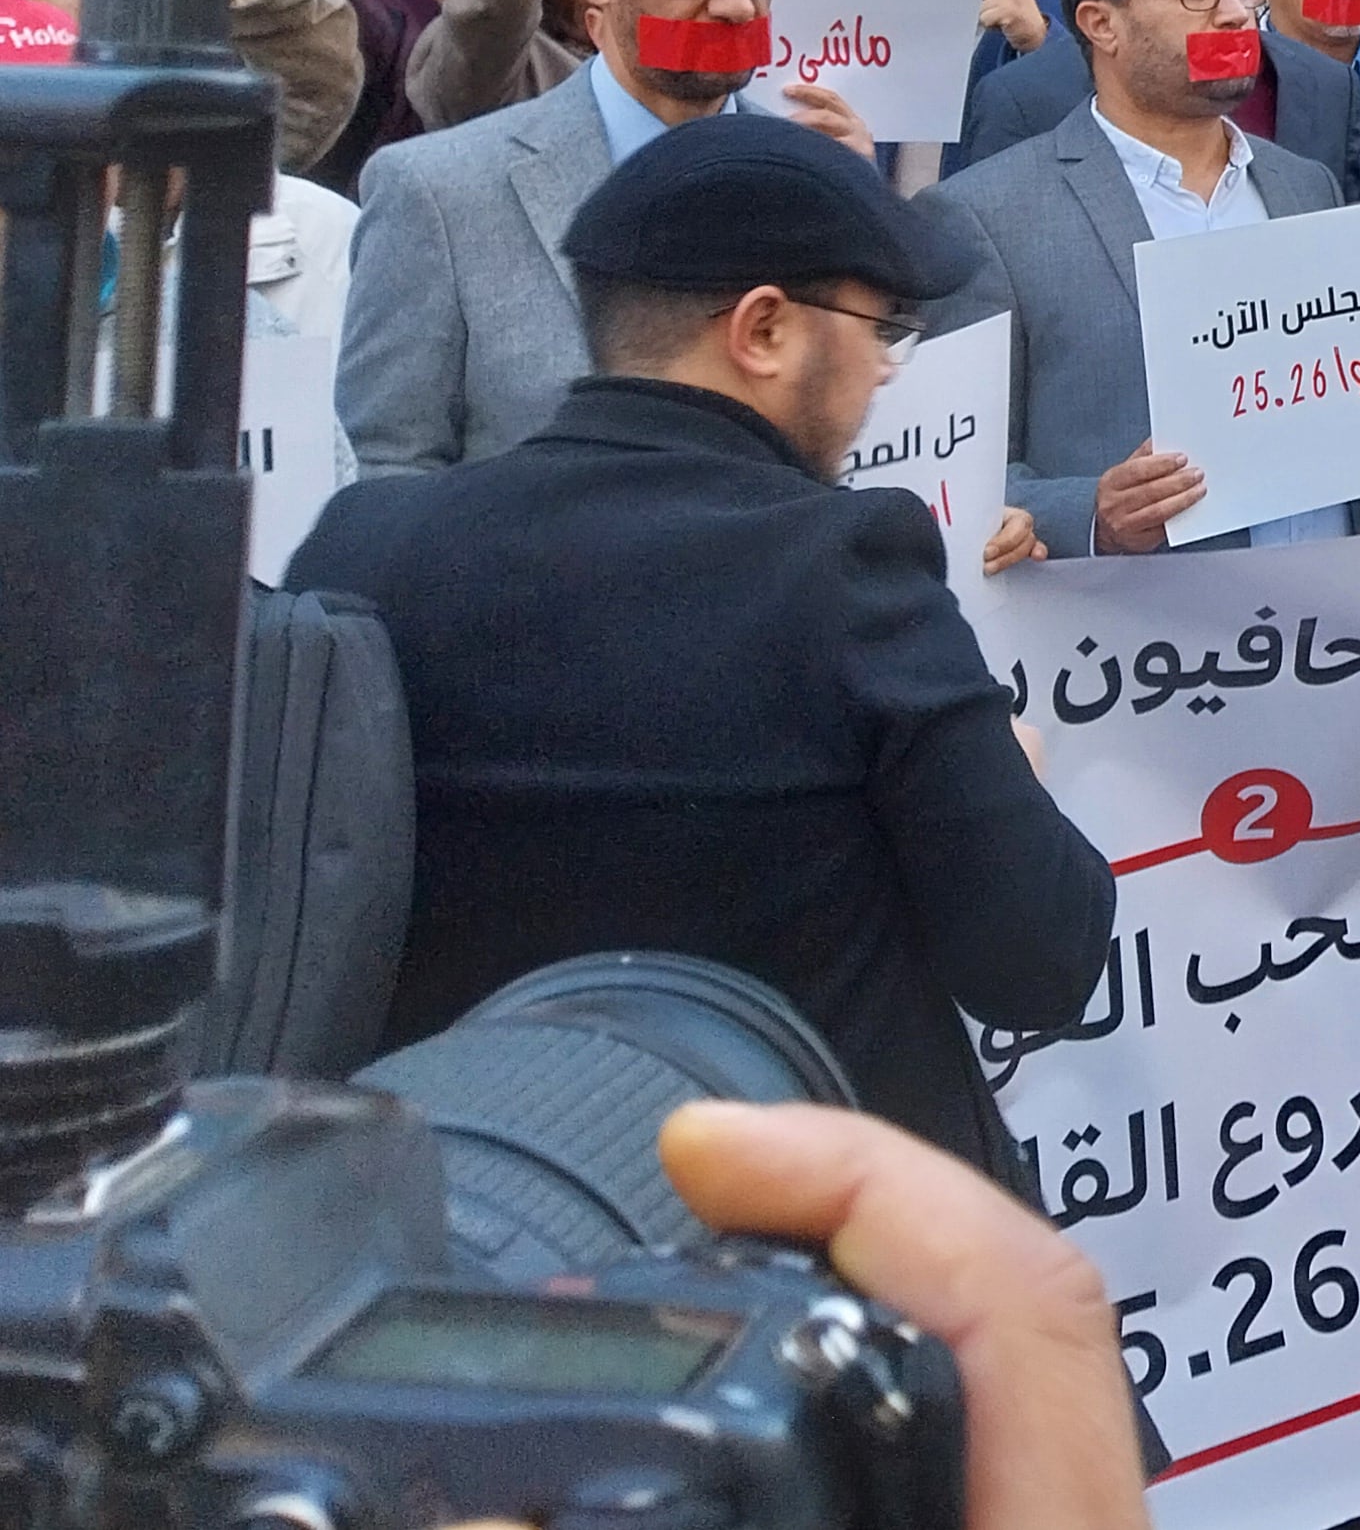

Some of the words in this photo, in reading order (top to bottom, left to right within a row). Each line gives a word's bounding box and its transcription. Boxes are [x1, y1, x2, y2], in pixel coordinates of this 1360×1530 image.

[1191, 299, 1270, 350] الآن..
[1231, 358, 1328, 418] 25.26
[840, 425, 922, 483] المج
[934, 413, 976, 459] حل
[1233, 783, 1277, 843] 2
